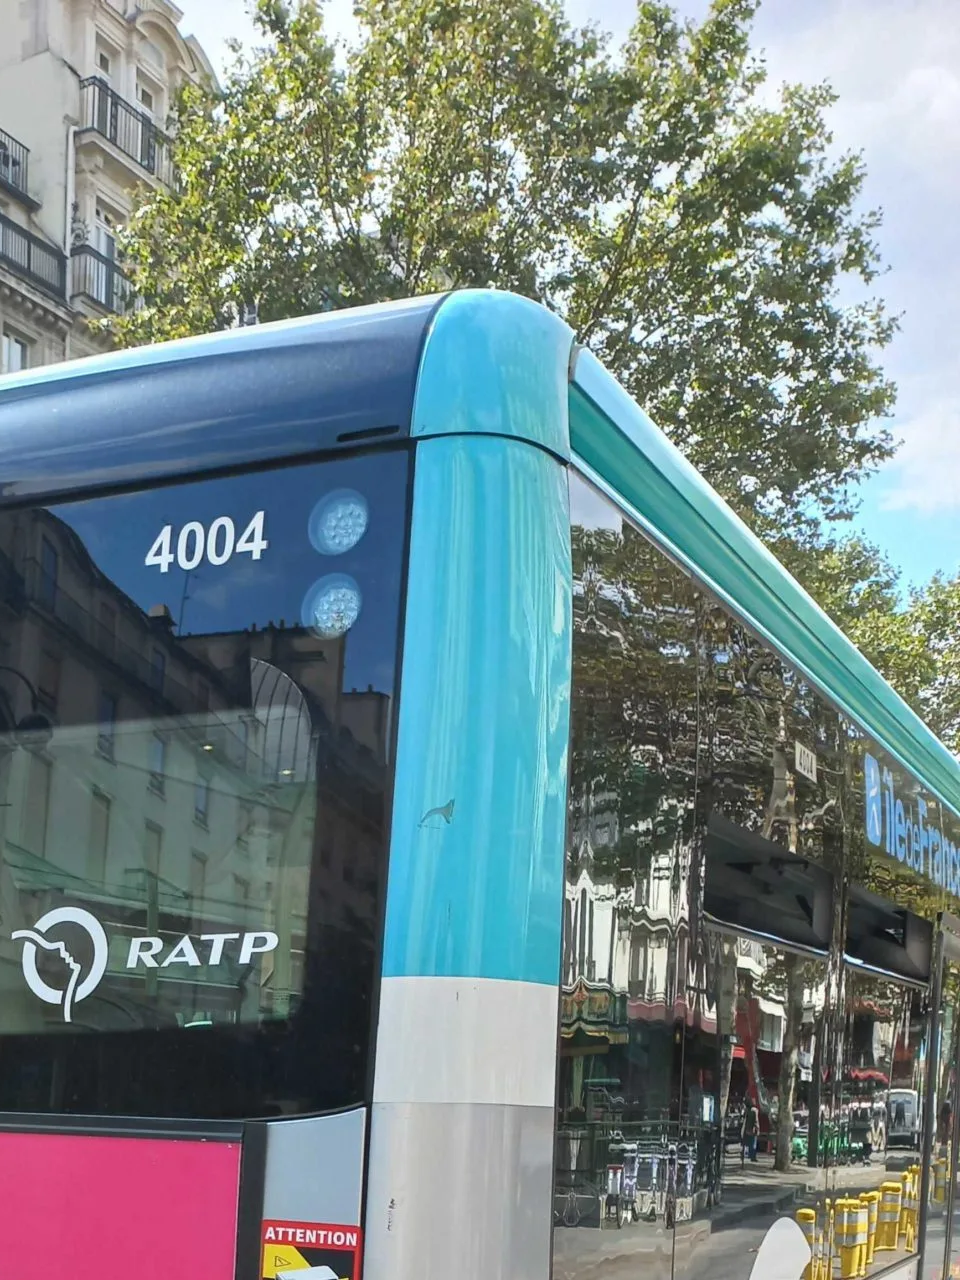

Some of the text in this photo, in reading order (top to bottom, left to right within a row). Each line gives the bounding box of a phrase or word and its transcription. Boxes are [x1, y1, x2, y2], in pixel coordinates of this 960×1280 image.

[144, 511, 269, 573] 4004
[126, 931, 279, 969] RATP
[265, 1226, 358, 1247] ATTENTION
